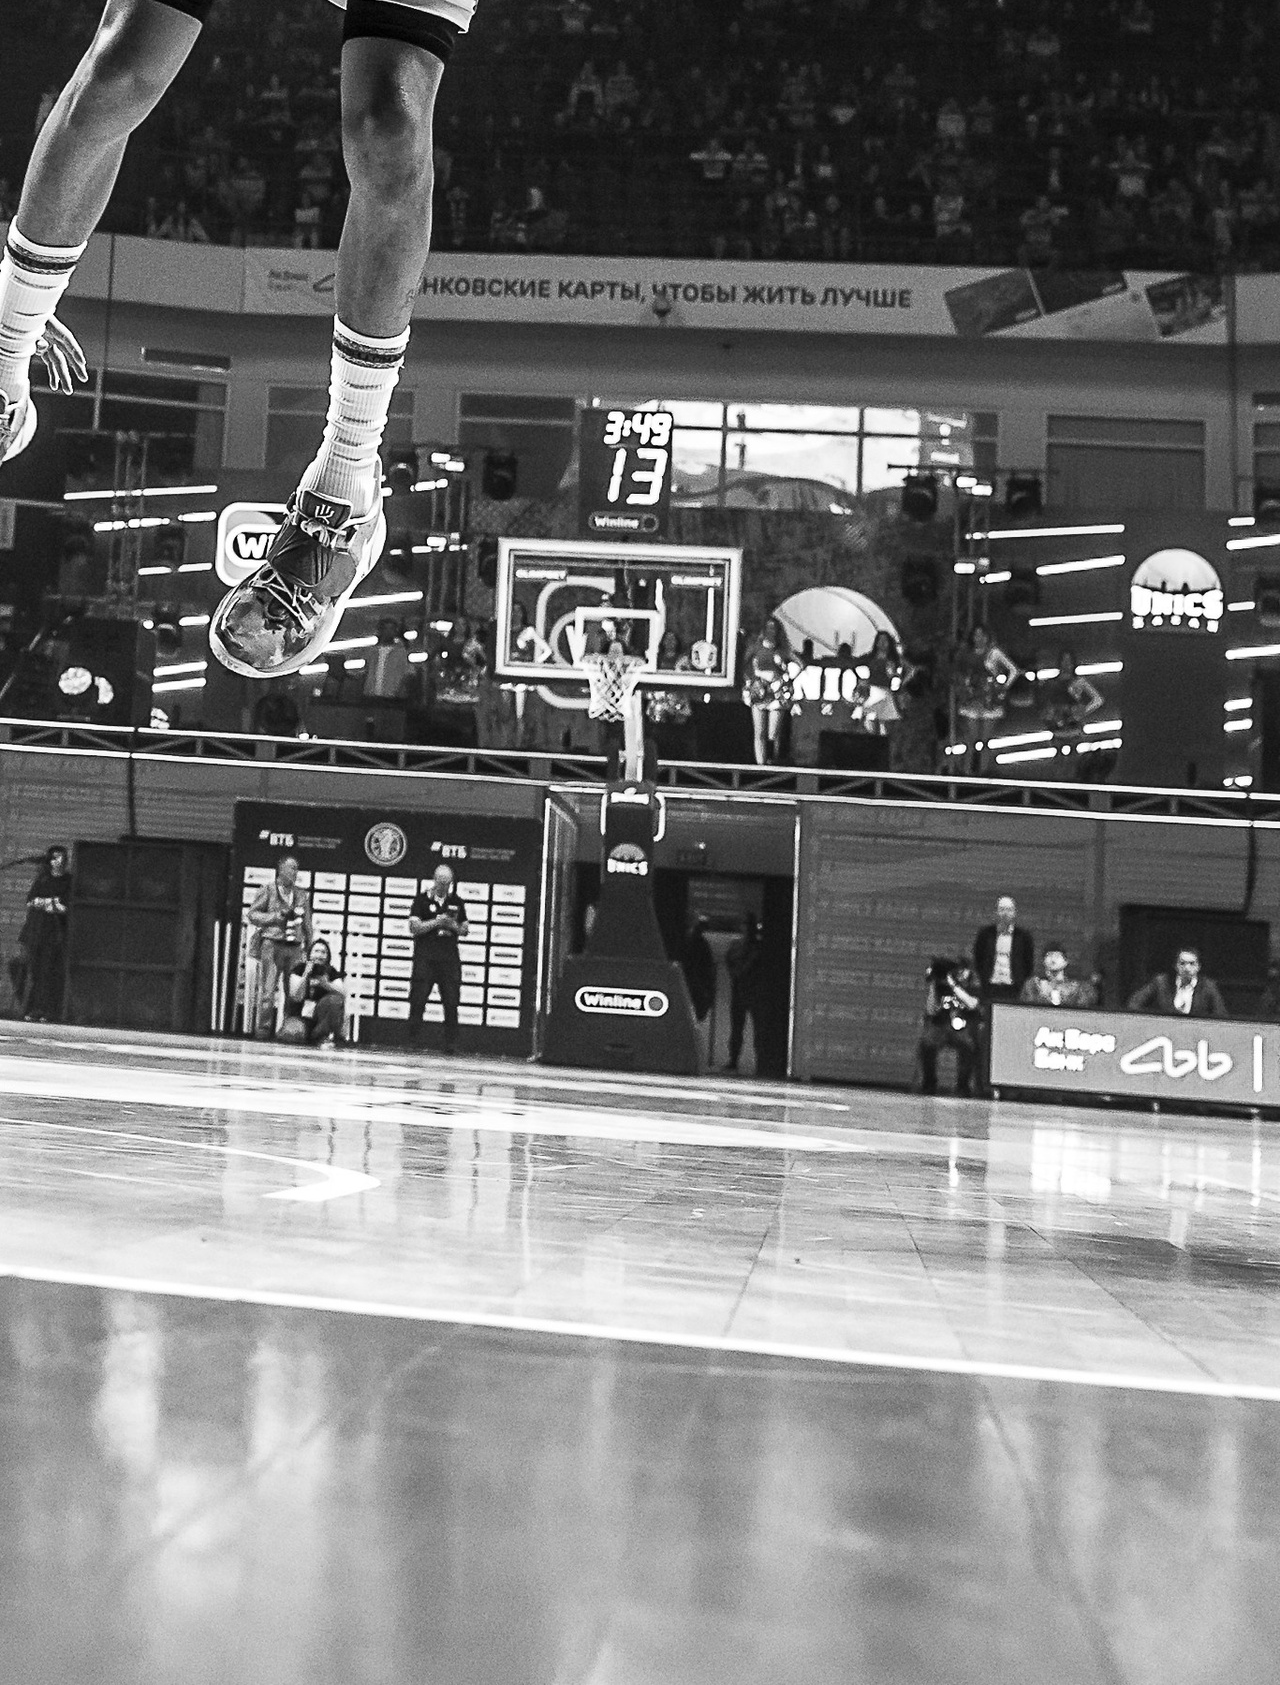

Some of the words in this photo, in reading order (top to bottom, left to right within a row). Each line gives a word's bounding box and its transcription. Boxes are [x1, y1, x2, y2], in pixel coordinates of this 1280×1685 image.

[422, 275, 551, 299] НКОВСКИЕ
[558, 278, 647, 303] КАРТЫ,
[653, 282, 737, 305] ЧТОБЫ
[742, 284, 816, 306] ЖИТЬ
[819, 287, 913, 309] ЛУЧШЕ
[603, 410, 673, 447] 3:49
[606, 447, 669, 506] 13
[1130, 584, 1224, 619] UNICS
[583, 992, 643, 1011] Winline
